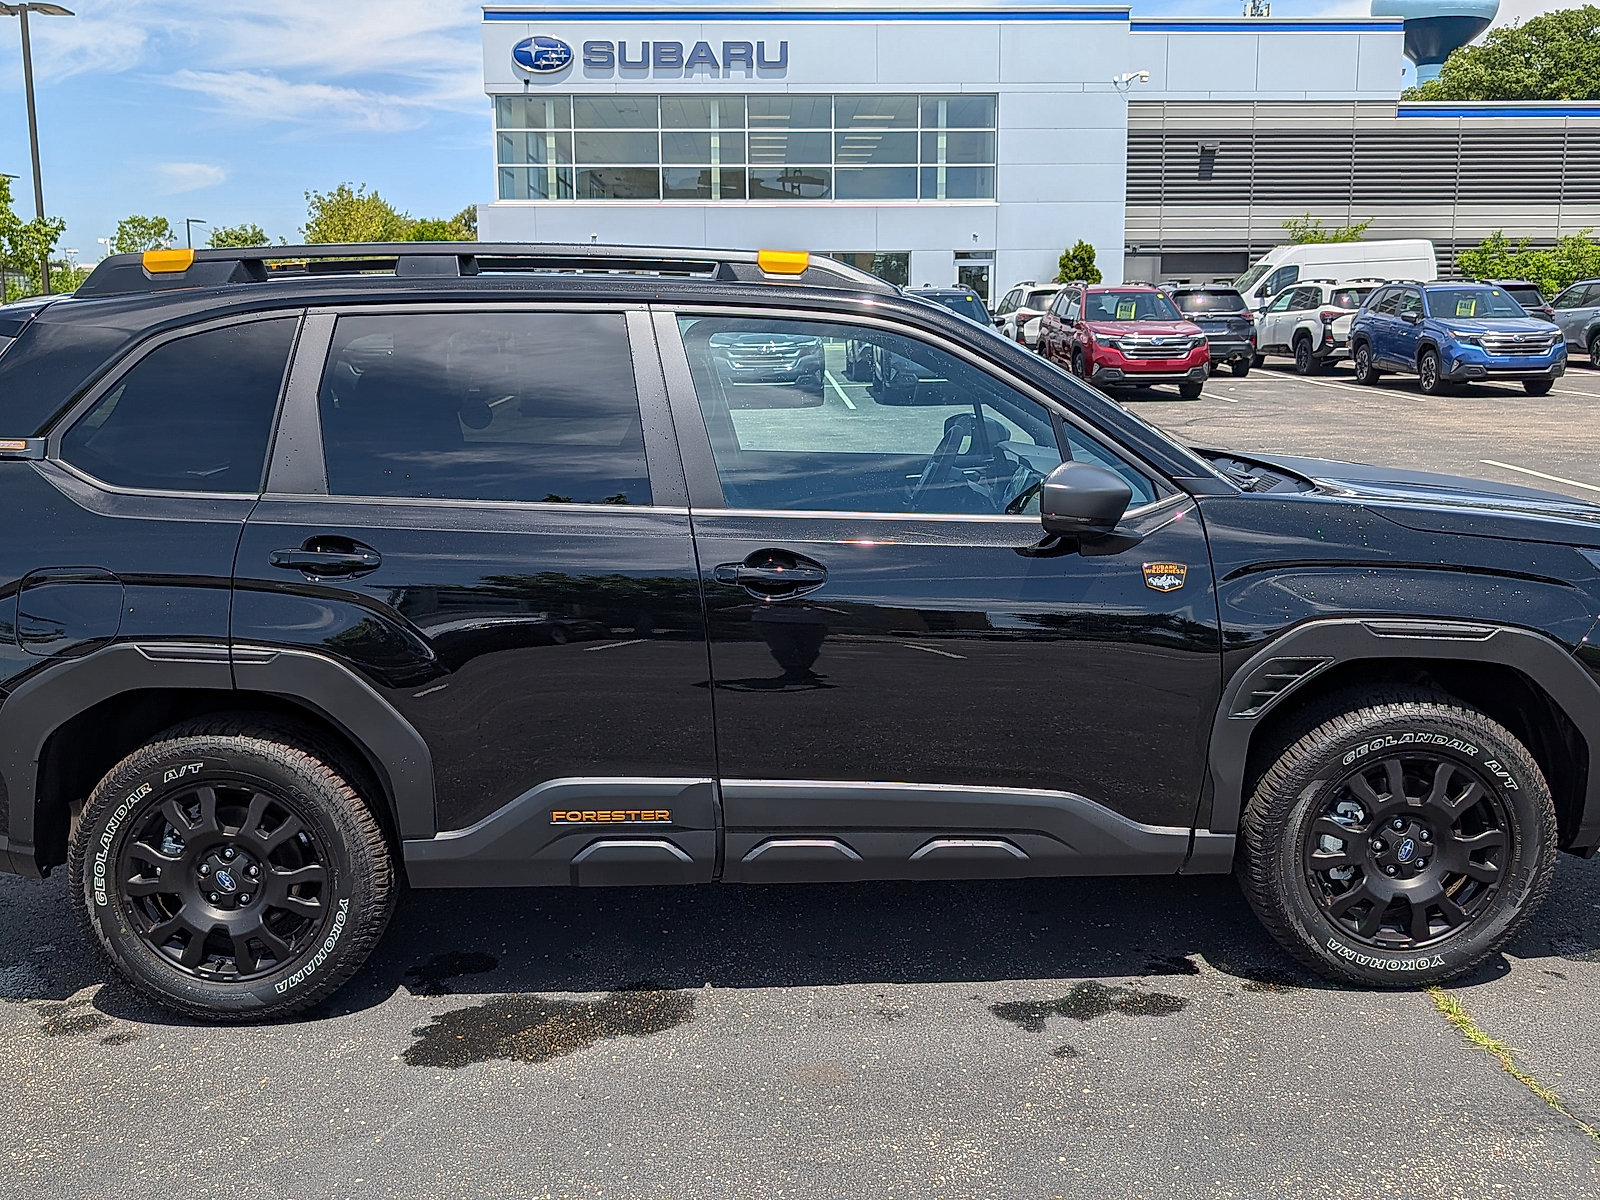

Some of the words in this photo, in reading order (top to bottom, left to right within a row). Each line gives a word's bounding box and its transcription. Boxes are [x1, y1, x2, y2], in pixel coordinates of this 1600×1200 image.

[582, 40, 789, 69] SUBARU
[1342, 731, 1479, 766] GEOLANDAR
[1484, 759, 1519, 791] A/T
[92, 782, 153, 907] GEOLANDAR
[163, 762, 204, 784] A/T
[551, 810, 671, 822] FORESTER
[274, 897, 350, 995] YOKOHAMA
[1326, 937, 1446, 972] YOKOHAMA
